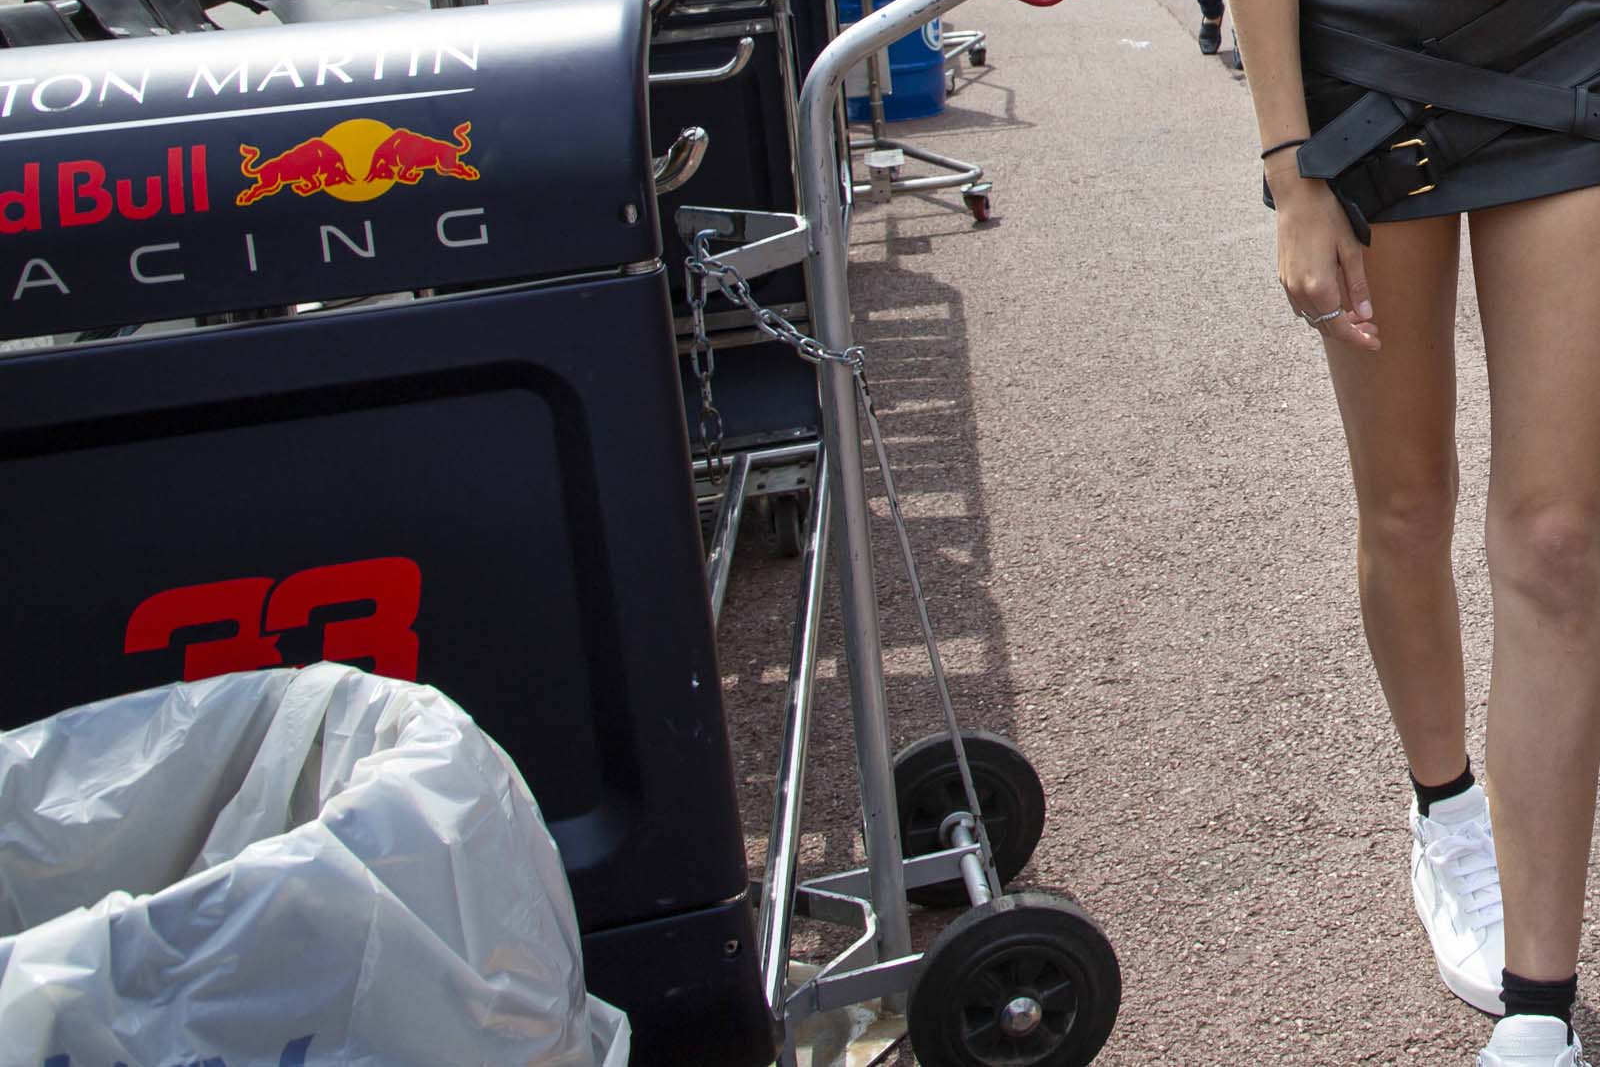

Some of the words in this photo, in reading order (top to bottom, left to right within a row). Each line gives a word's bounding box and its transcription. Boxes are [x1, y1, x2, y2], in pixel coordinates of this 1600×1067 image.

[187, 39, 480, 99] MARTIN
[58, 144, 210, 228] Bull
[124, 555, 422, 682] 33
